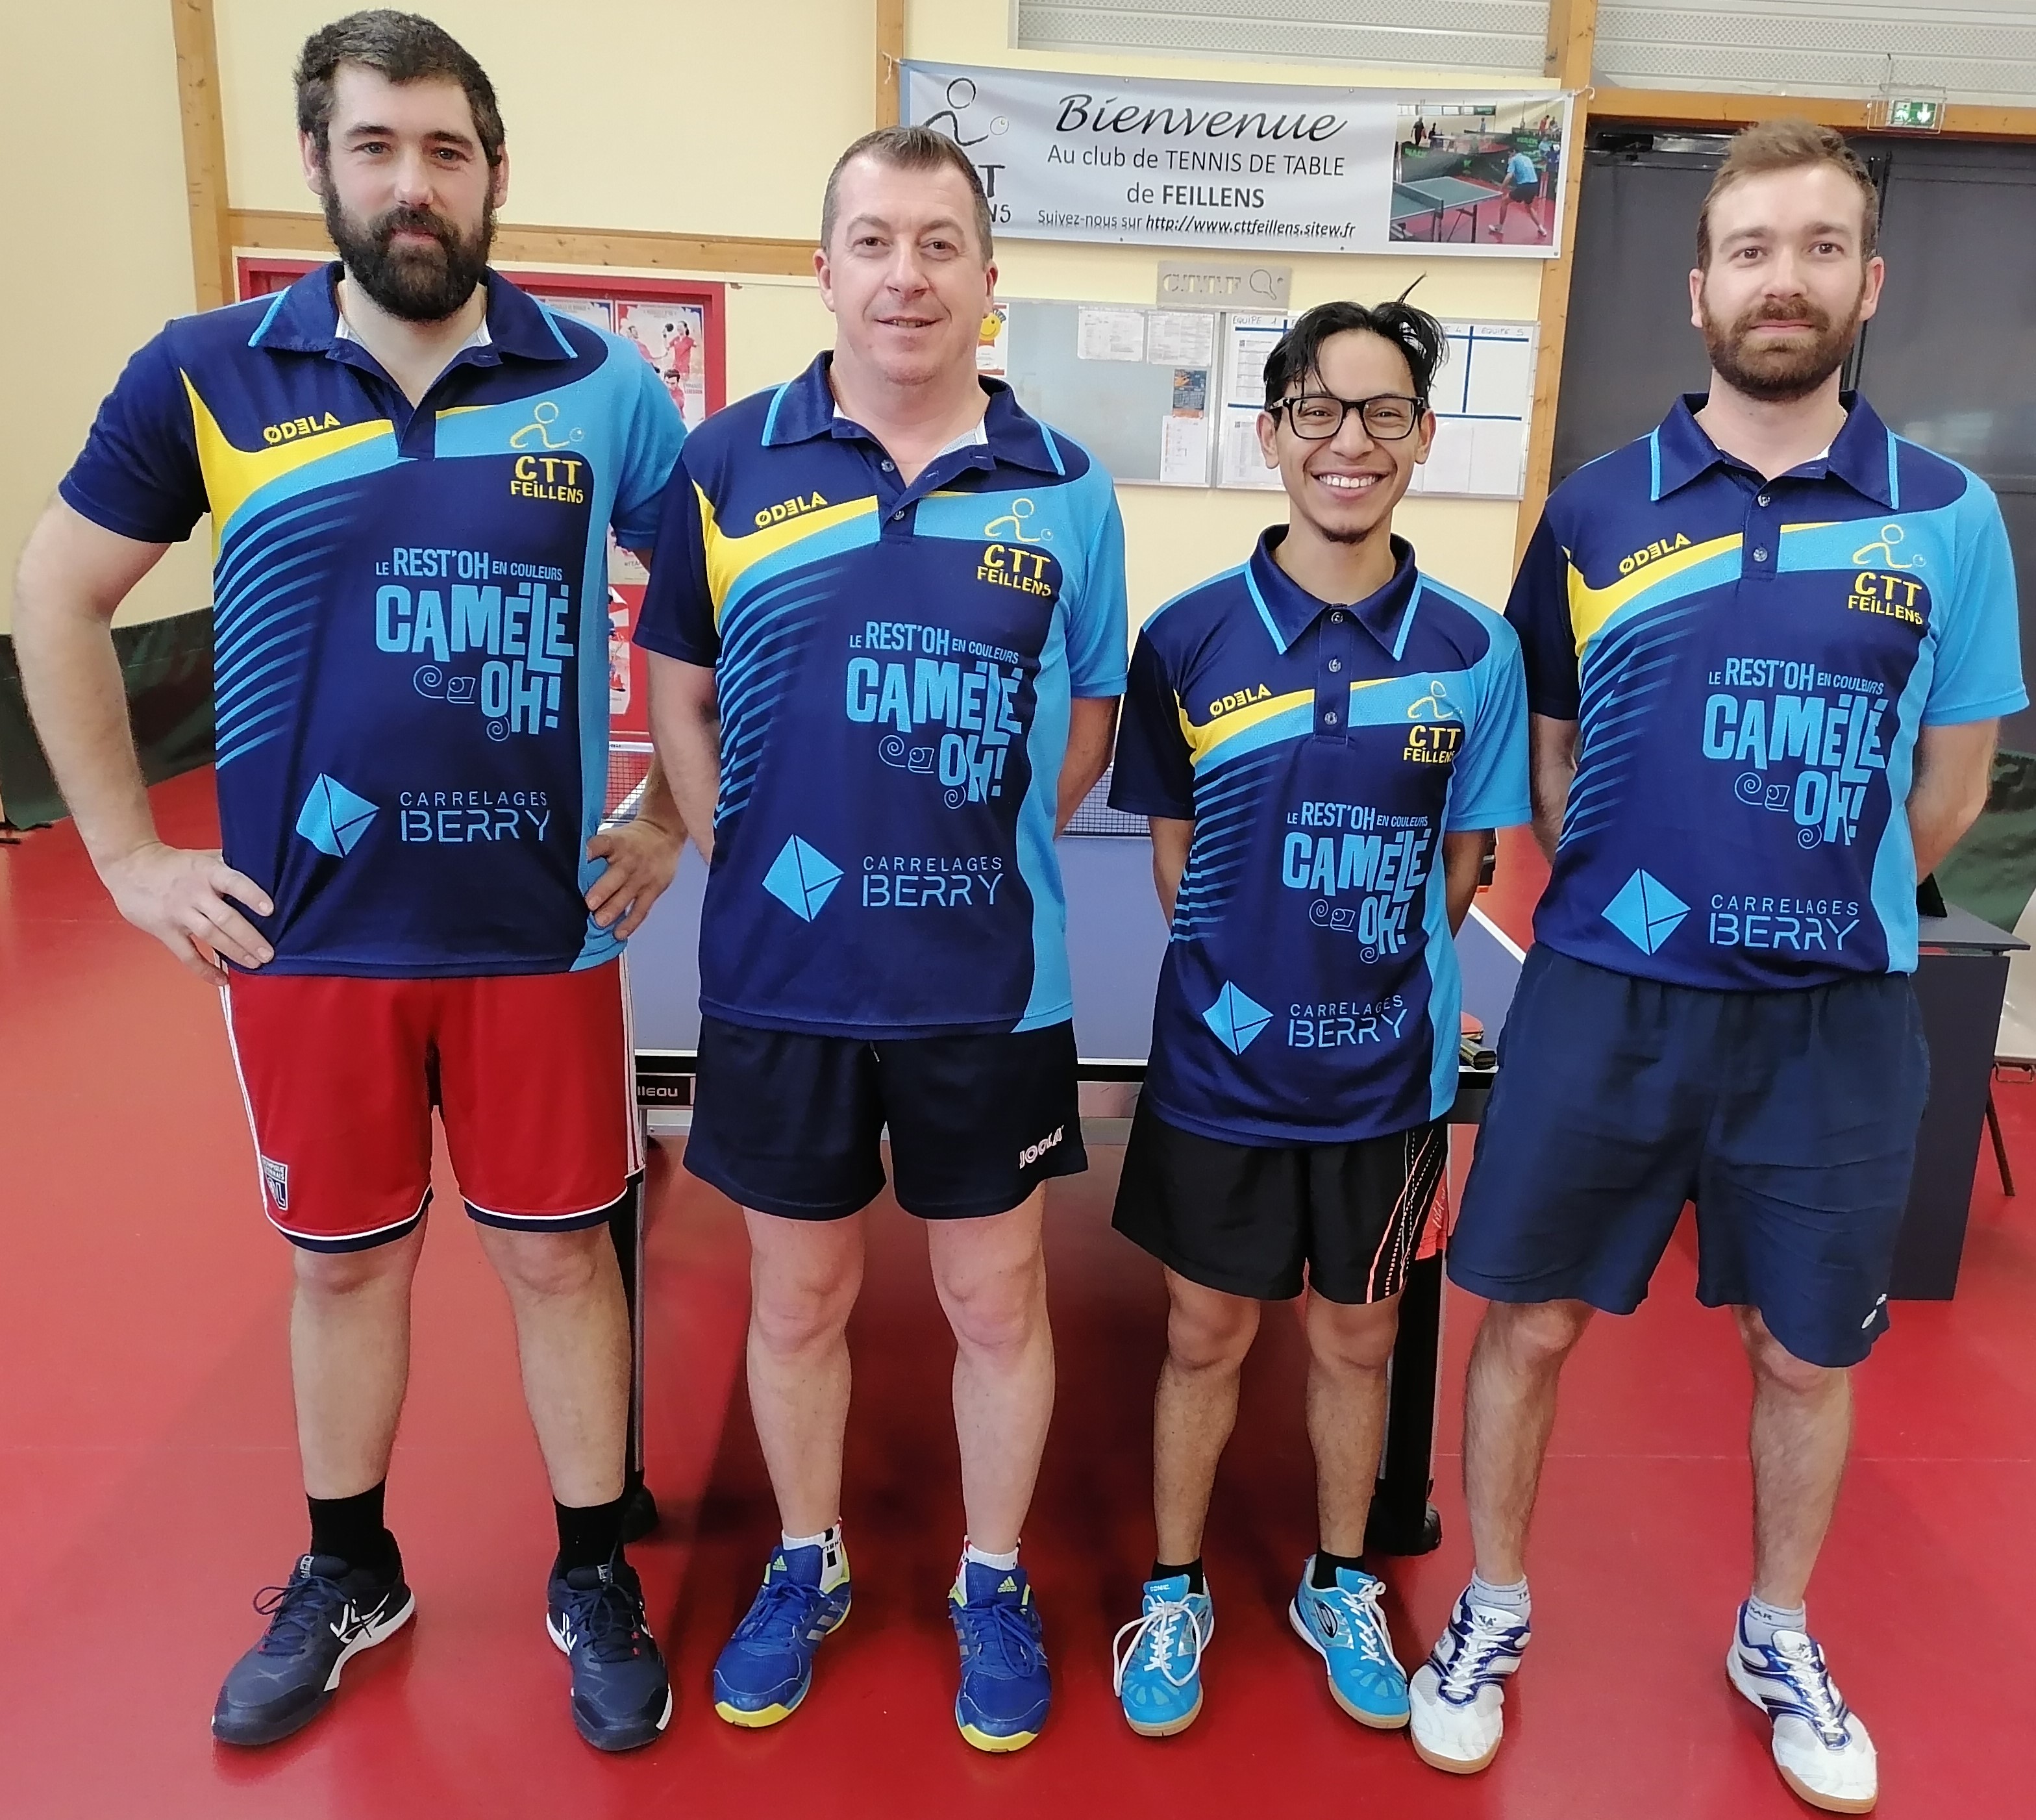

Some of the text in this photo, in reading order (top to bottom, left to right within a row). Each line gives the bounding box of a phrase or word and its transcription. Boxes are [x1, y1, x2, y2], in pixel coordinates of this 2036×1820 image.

[1056, 93, 1348, 142] Bienvenue
[1047, 144, 1346, 176] Au club de TENNIS DE TABLE
[1127, 182, 1265, 208] de FEILLENS
[1038, 210, 1356, 238] Suivez-nous sur http://www.cttfeillens.sitew.fr
[514, 455, 582, 486] CTT
[376, 547, 563, 581] LE REST'OH EN COULEURS
[984, 544, 1051, 579] CTT
[1854, 571, 1922, 606] CTT
[850, 621, 1019, 665] LE REST'OH EN COULEURS
[1708, 657, 1885, 695] LE REST'OH EN COULEURS
[480, 660, 561, 735] OH!
[1409, 725, 1461, 749] CTT
[939, 732, 1008, 805] OH!
[400, 791, 547, 806] CARRELAGES
[1793, 770, 1867, 846] OH!
[401, 808, 551, 842] BERRY
[1287, 801, 1428, 831] LE REST'OH EN COULEURS
[862, 856, 1002, 872] CARRELAGES
[862, 873, 1005, 907] BERRY
[1711, 894, 1859, 916] CARRELAGES
[1358, 894, 1411, 955] OH!
[1709, 912, 1861, 951] BERRY
[1290, 995, 1404, 1018] CARRELAGES
[1288, 1008, 1408, 1048] BERRY
[637, 1086, 678, 1097] lleau
